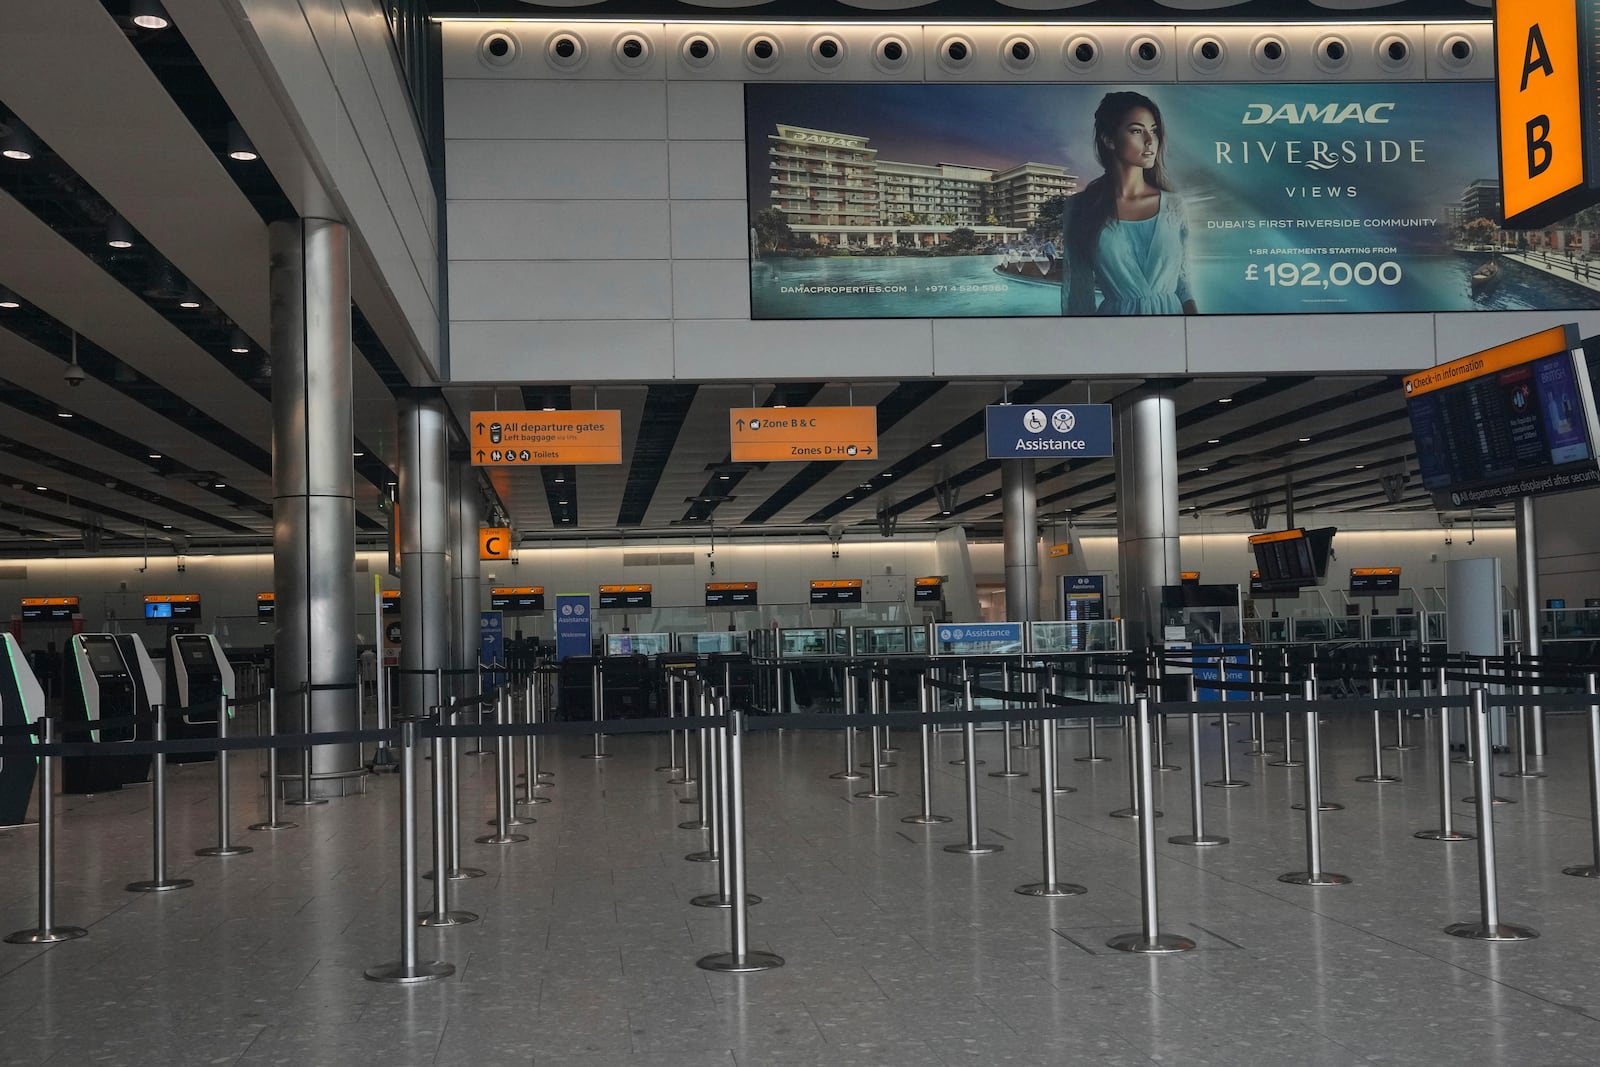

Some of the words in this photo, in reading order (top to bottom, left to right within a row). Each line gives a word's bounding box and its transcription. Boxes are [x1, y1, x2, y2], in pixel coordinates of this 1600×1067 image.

[1520, 23, 1554, 92] A
[1241, 103, 1395, 124] DAMAC
[794, 132, 858, 147] DAMAC
[1526, 114, 1553, 179] B
[1215, 140, 1426, 169] RIVERSIDE
[1285, 186, 1358, 198] VIEWS
[1207, 220, 1256, 229] DUBAI'S
[1259, 220, 1294, 228] FIRST
[1296, 220, 1360, 228] RIVERSIDE
[1364, 219, 1437, 227] COMMUNITY
[1245, 262, 1402, 290] £192,000
[1413, 372, 1442, 389] Check-in
[1443, 360, 1484, 379] information
[504, 423, 518, 432] All
[521, 423, 573, 433] departure
[576, 423, 605, 433] gates
[763, 420, 788, 428] Zone
[792, 419, 798, 427] B
[800, 419, 807, 427] &
[809, 419, 816, 427] C
[521, 434, 556, 442] baggage
[1016, 438, 1086, 450] Assistance
[534, 451, 559, 459] Toilets
[791, 446, 822, 455] Zones
[825, 446, 845, 454] D-H
[1460, 492, 1468, 501] All
[1468, 488, 1501, 500] departures
[1502, 484, 1520, 496] gates
[1520, 478, 1553, 492] displayed
[1553, 474, 1570, 485] after
[1571, 470, 1600, 482] security
[486, 537, 500, 555] C
[966, 628, 1010, 637] Assistance
